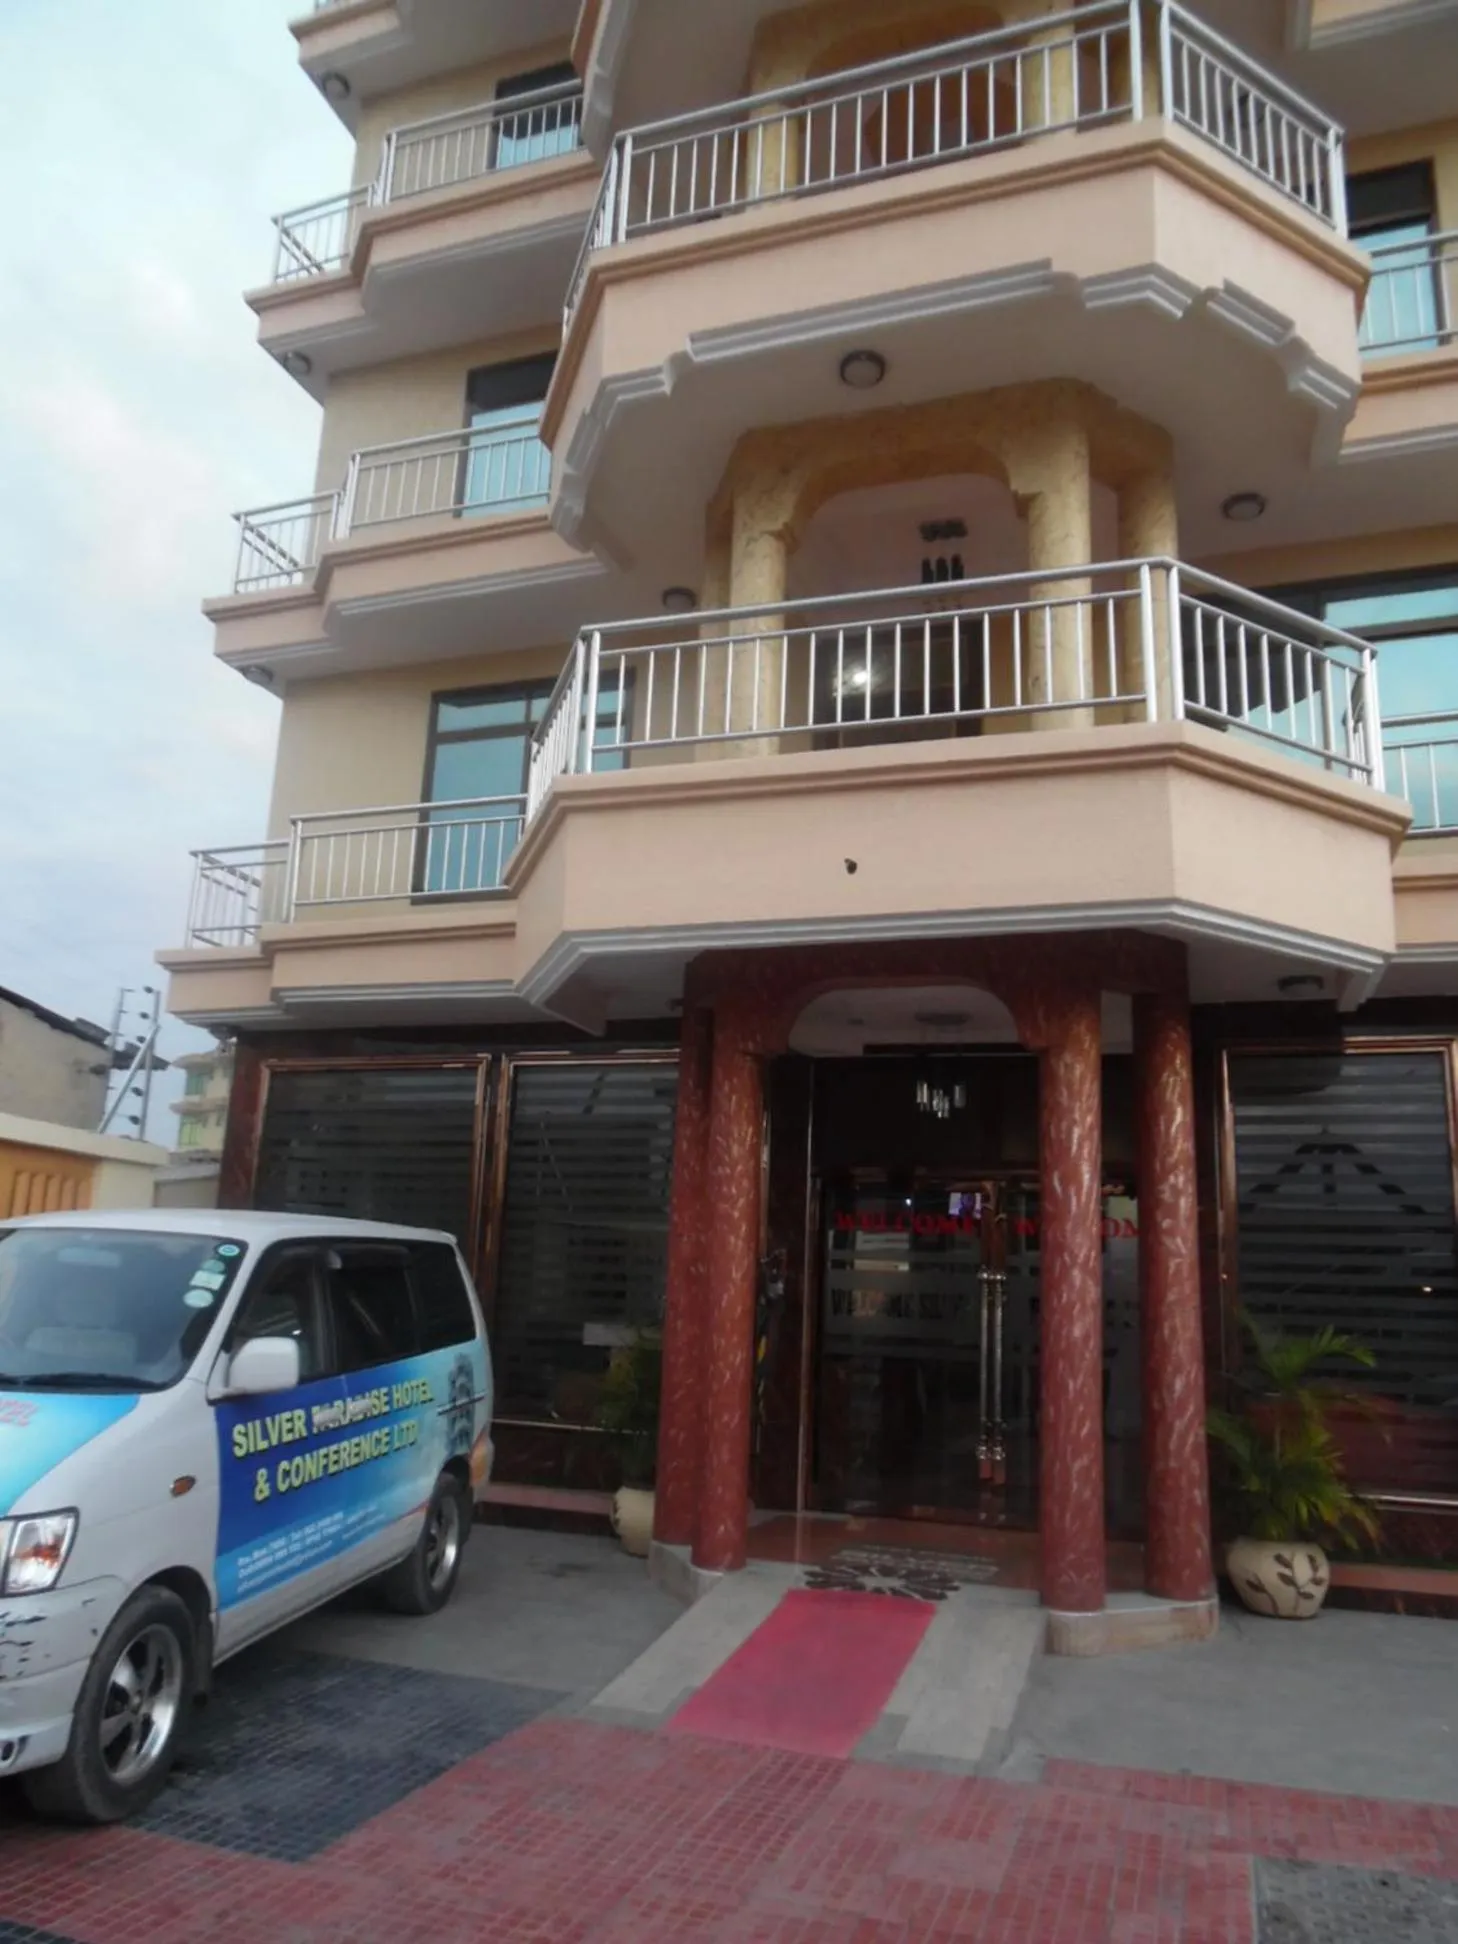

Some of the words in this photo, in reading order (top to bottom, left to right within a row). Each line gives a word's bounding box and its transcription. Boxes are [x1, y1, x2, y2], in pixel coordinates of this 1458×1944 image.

[833, 1210, 976, 1236] WELCOME
[232, 1411, 308, 1458] SILVER
[391, 1378, 436, 1410] HOTEL
[253, 1468, 271, 1502] &
[276, 1431, 390, 1493] CONFERENCE
[392, 1420, 419, 1451] LTD
